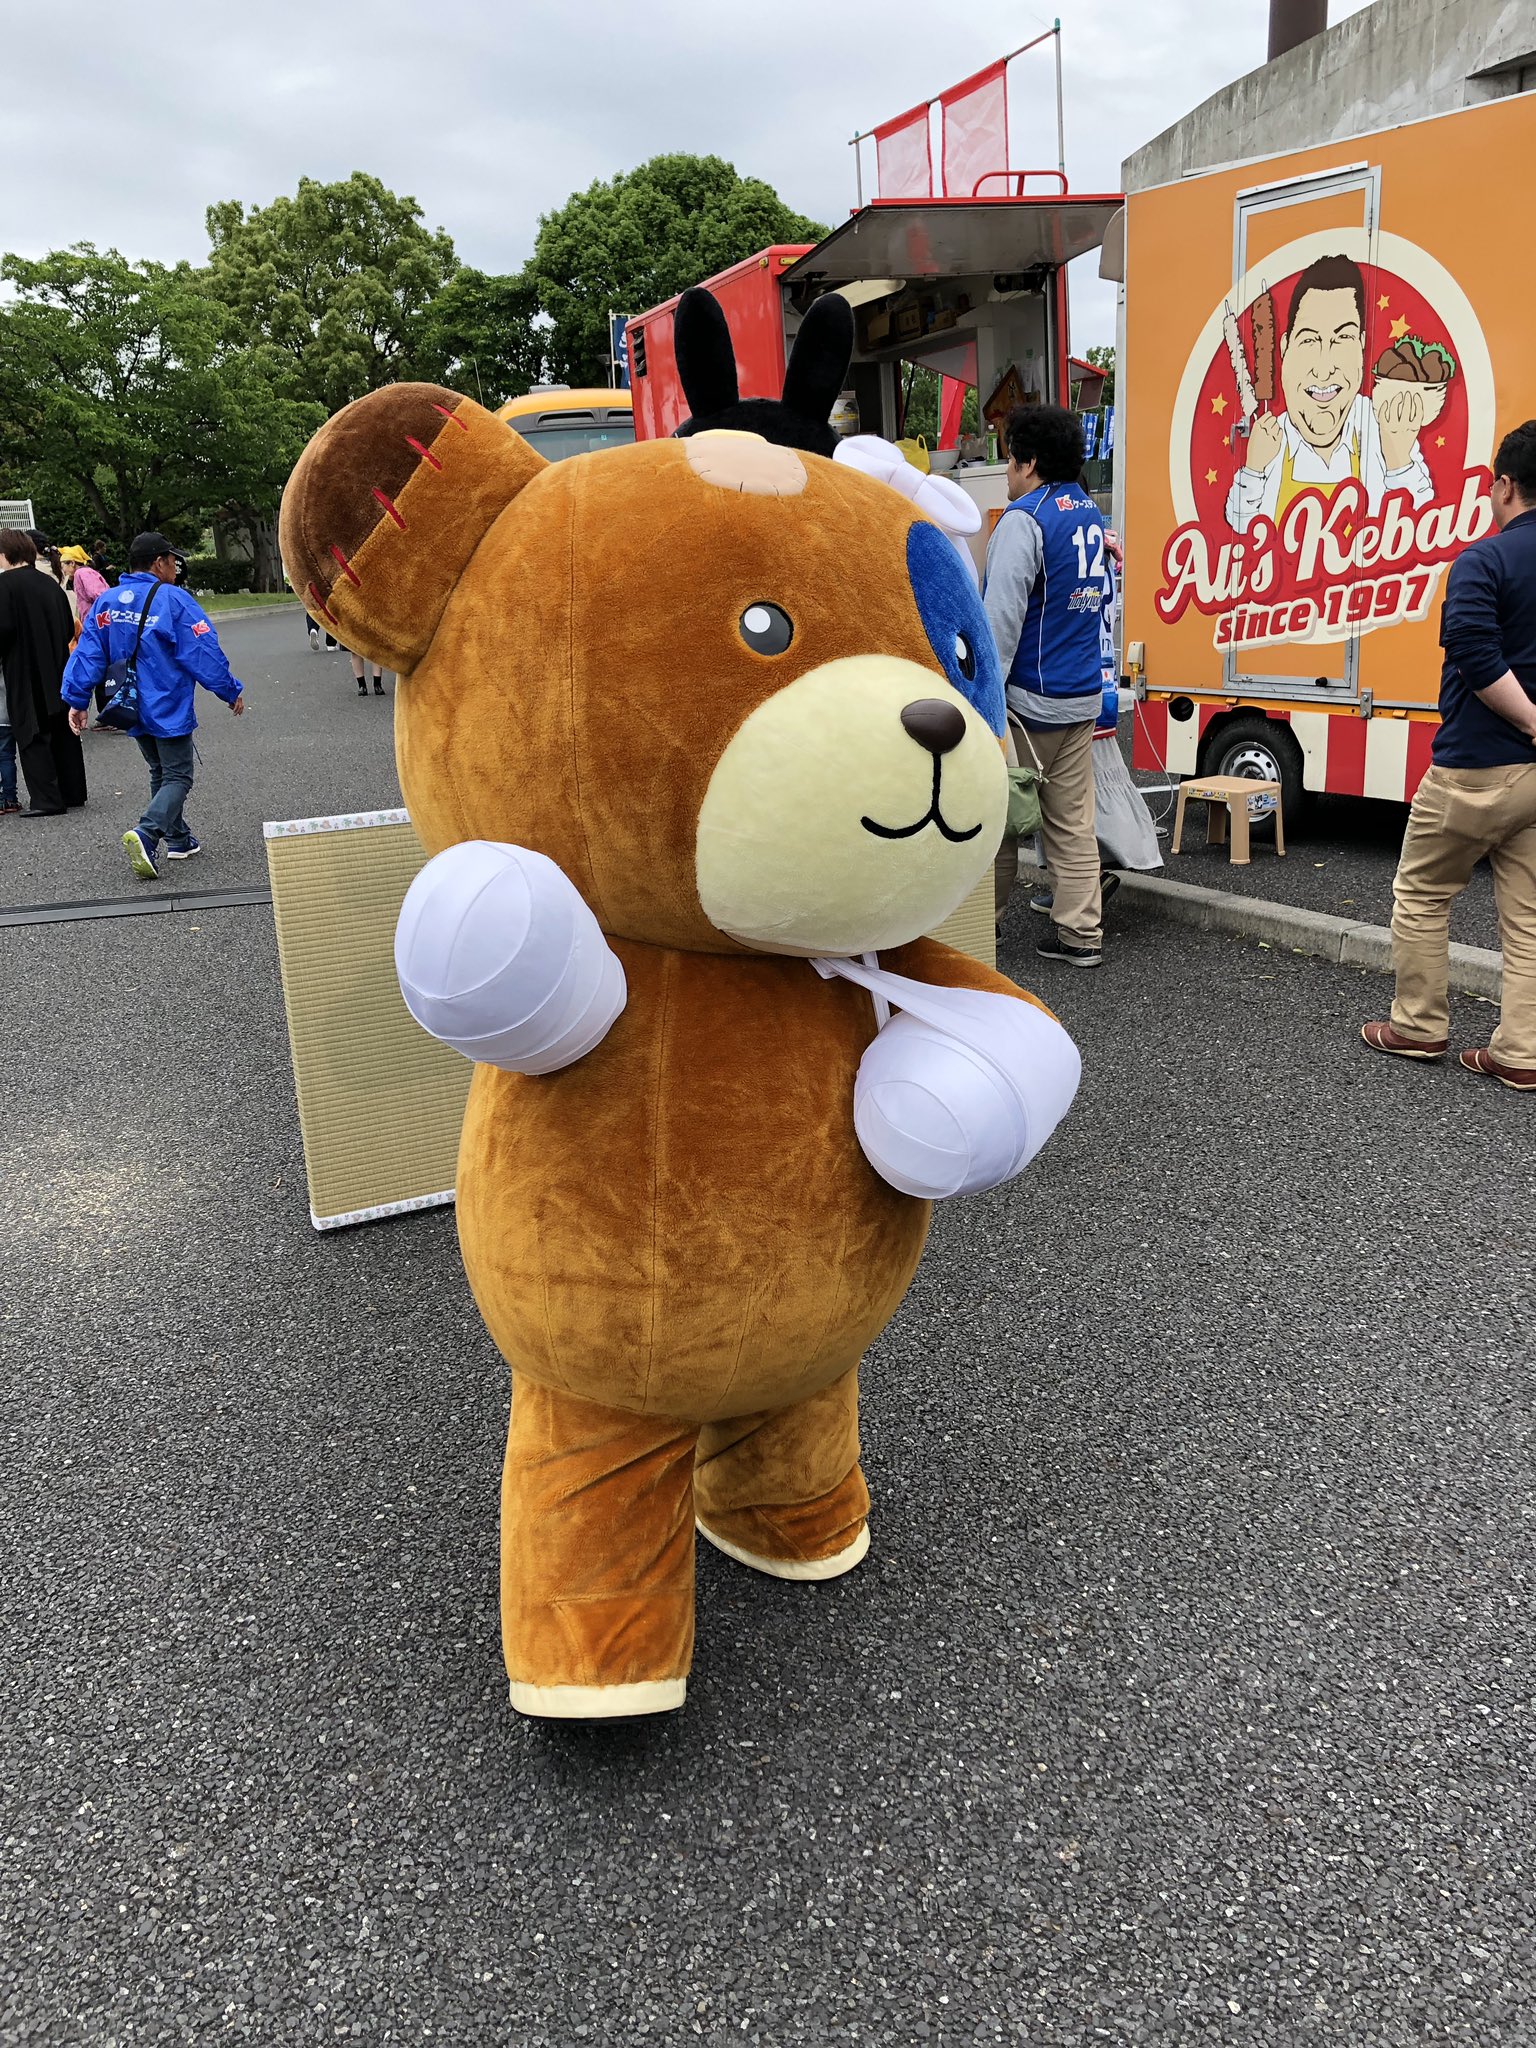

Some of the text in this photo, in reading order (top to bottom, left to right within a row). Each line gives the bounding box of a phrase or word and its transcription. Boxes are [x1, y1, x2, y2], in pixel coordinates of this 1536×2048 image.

[1072, 524, 1105, 579] 12
[1159, 520, 1275, 613] Ali's
[1283, 474, 1494, 583] Kebab
[1216, 573, 1432, 644] since 1997
